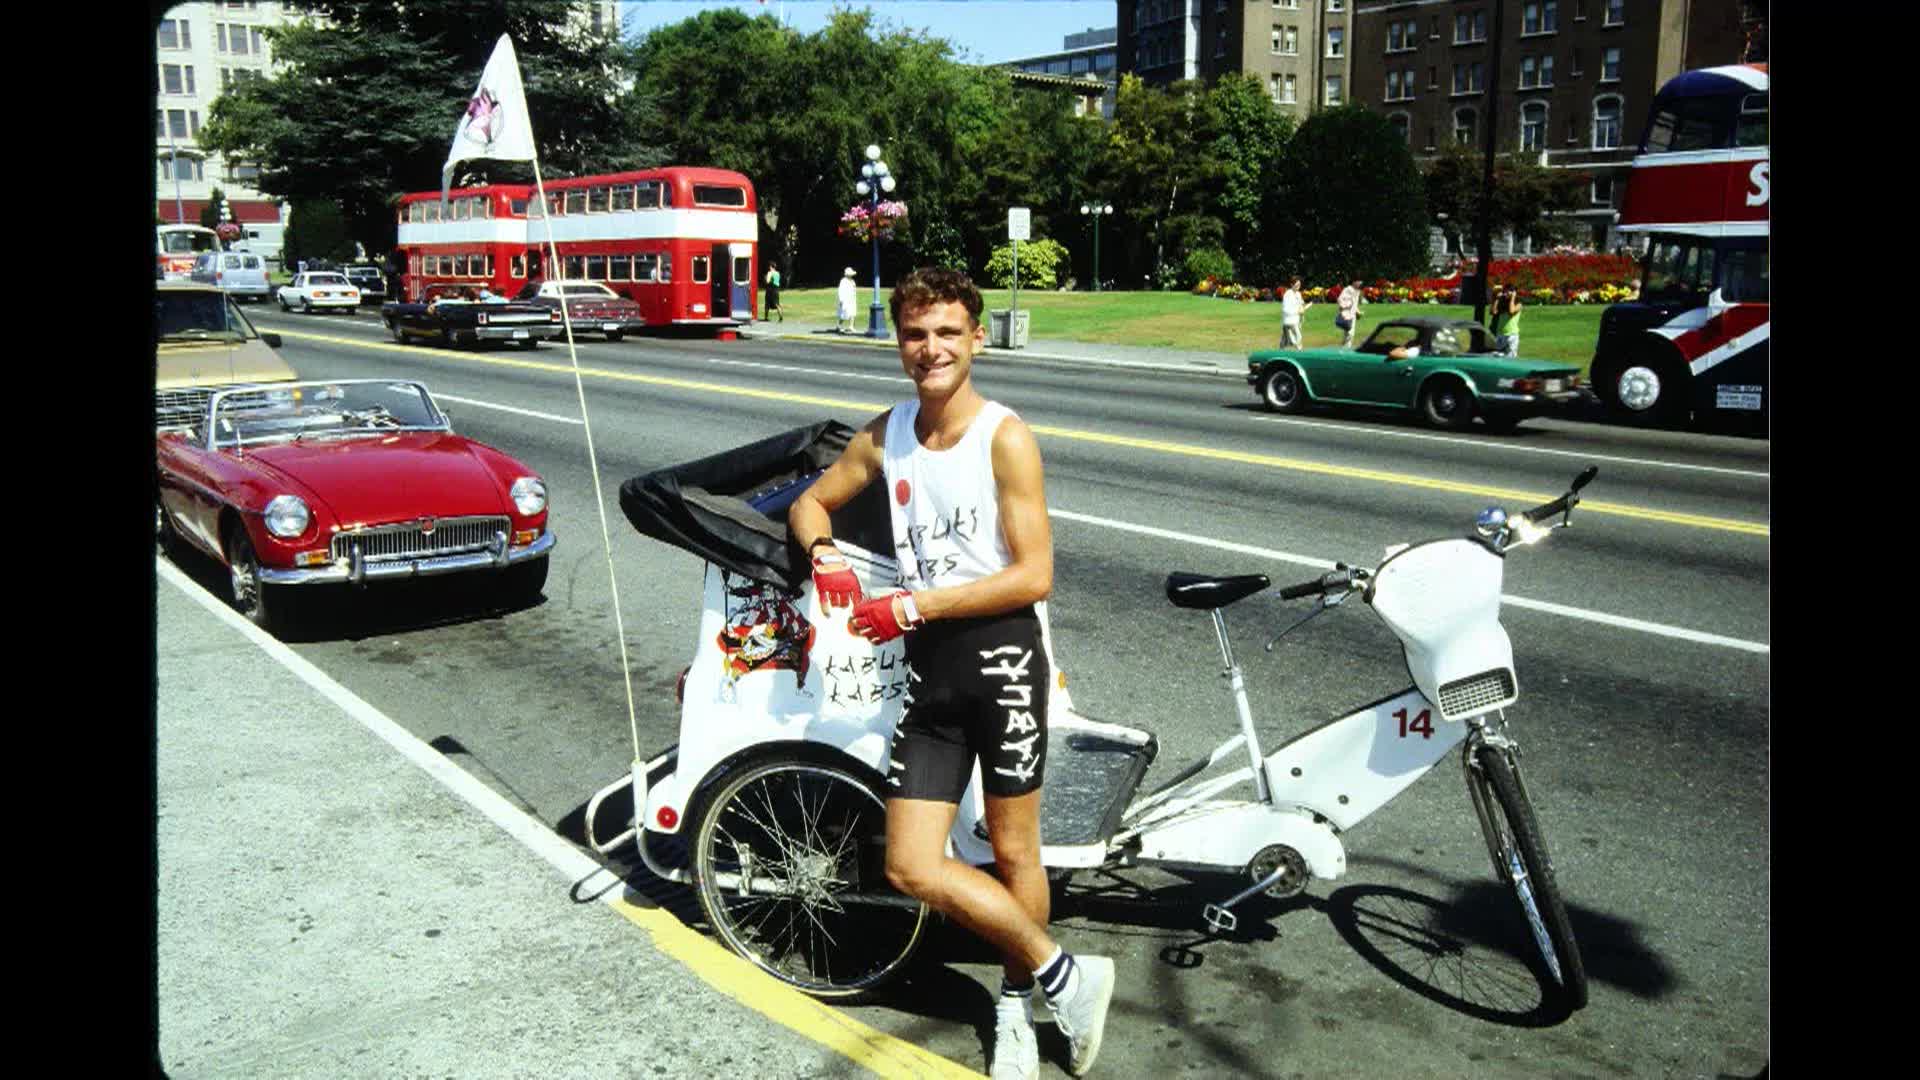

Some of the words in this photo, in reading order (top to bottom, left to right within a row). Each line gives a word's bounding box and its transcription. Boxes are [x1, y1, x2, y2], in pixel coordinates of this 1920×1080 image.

[897, 505, 978, 555] ABUKI
[830, 681, 904, 708] KABS
[979, 645, 1040, 783] KABUKI
[1392, 707, 1435, 739] 14
